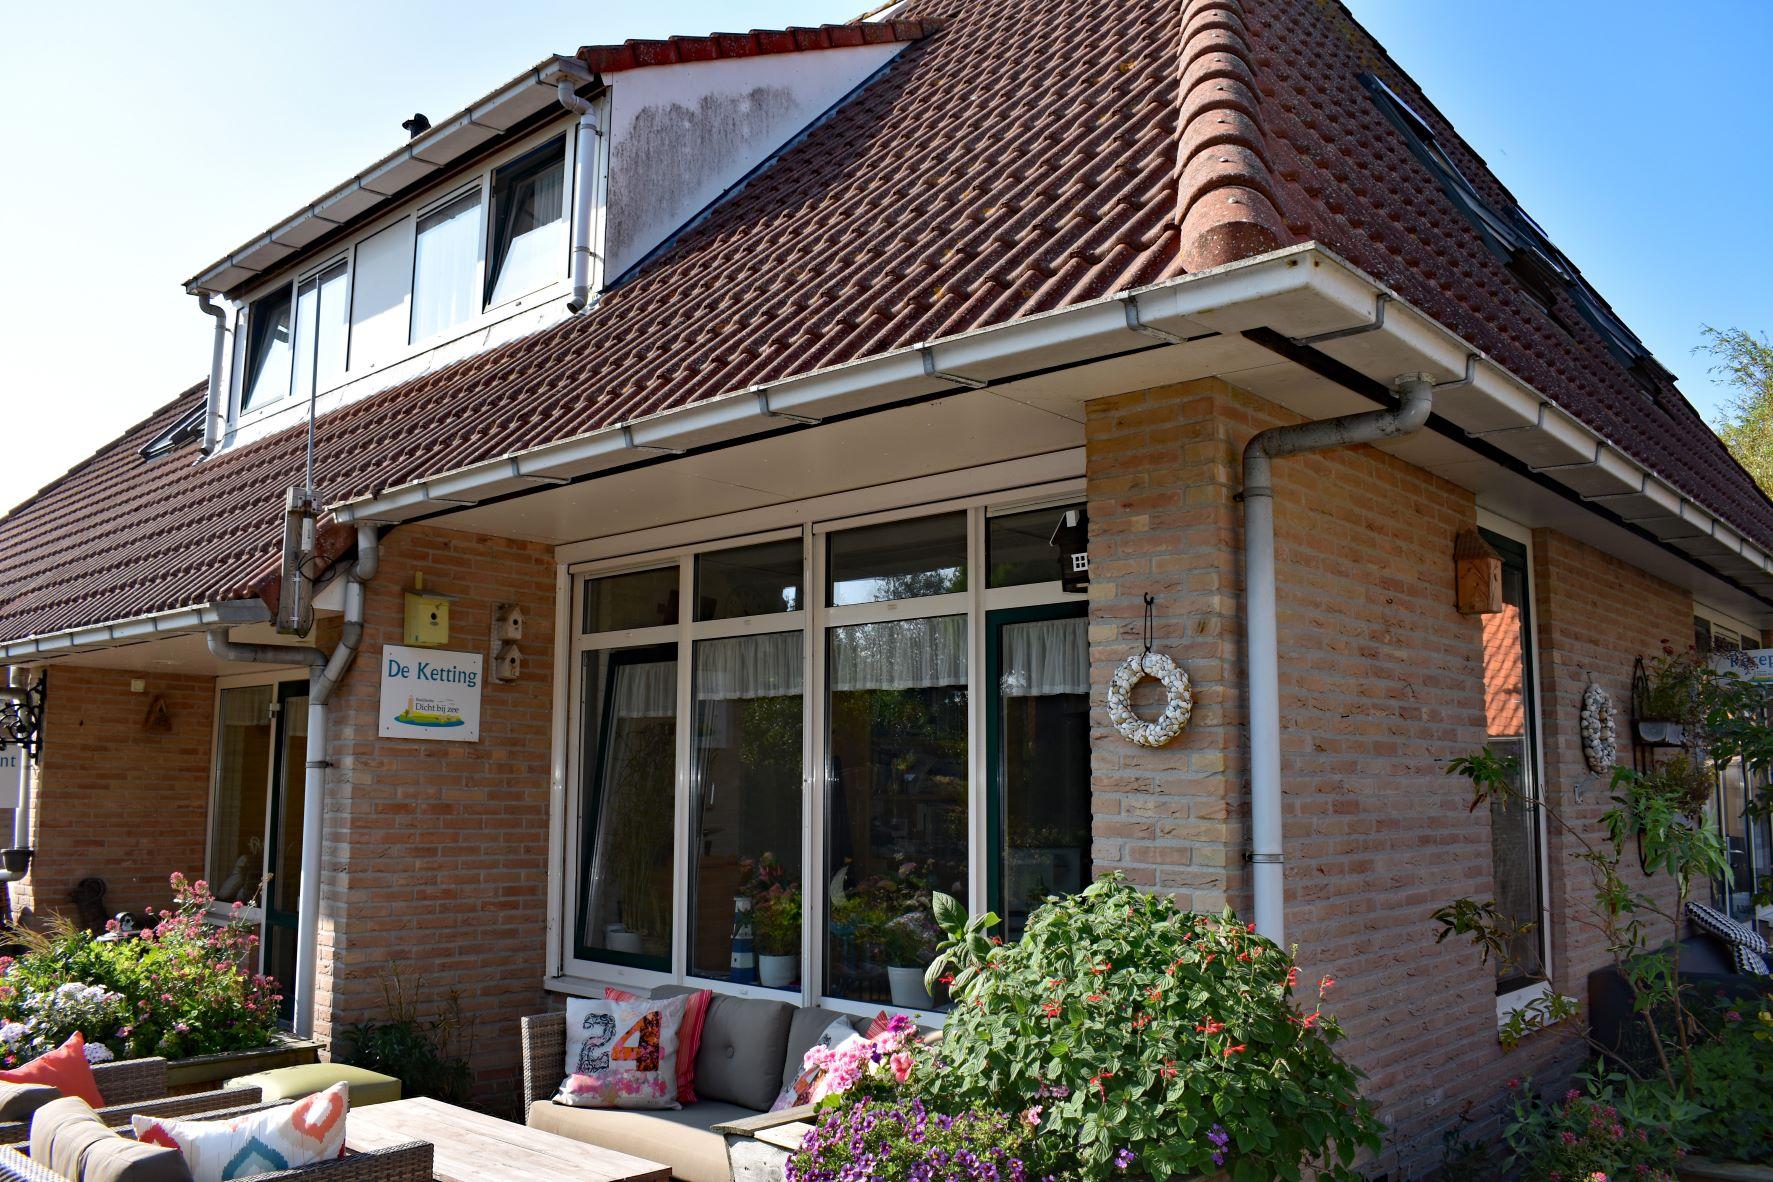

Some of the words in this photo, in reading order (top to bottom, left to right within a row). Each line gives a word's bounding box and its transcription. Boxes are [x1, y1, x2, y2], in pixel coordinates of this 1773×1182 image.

[388, 659, 410, 679] De
[417, 662, 478, 688] Ketting
[415, 702, 435, 712] Dicht
[436, 704, 446, 714] bij
[576, 1011, 665, 1073] 24
